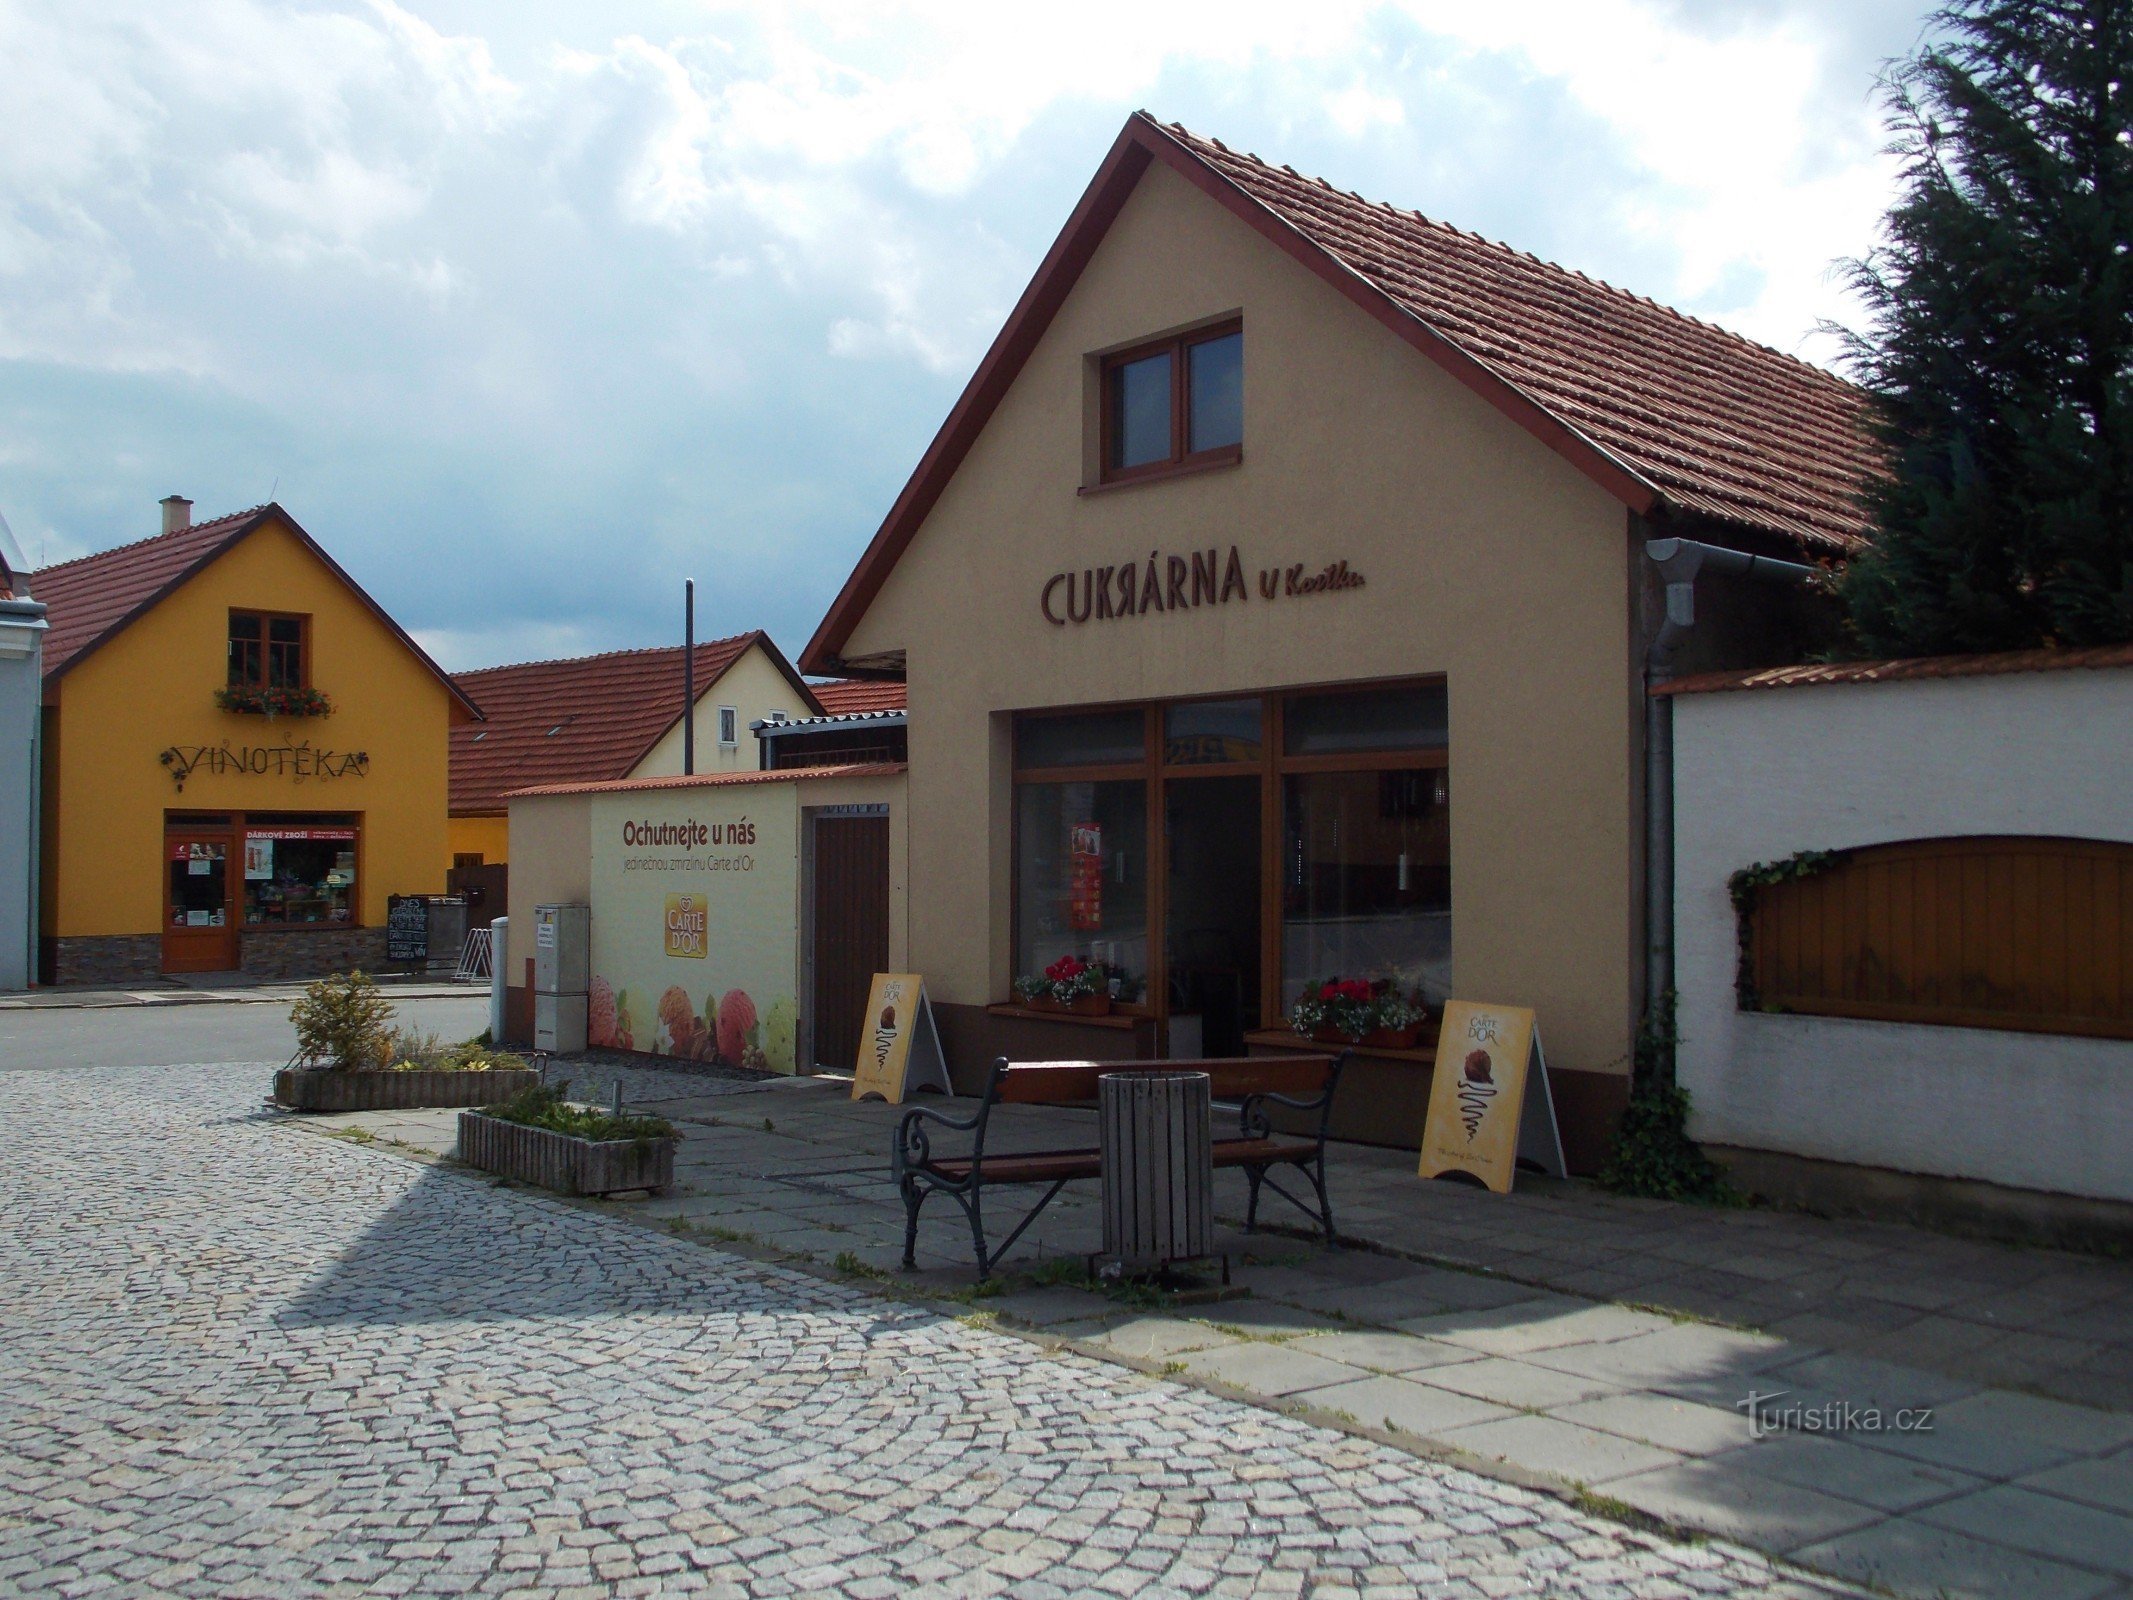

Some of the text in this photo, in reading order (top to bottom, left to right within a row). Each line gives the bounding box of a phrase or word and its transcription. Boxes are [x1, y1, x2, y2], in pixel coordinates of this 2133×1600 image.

[169, 739, 365, 778] VINOTÉKA
[246, 830, 283, 839] DÁRKOVÉ
[623, 815, 756, 851] Ochutnejte u nás
[623, 855, 668, 873] jedinečnou
[669, 855, 705, 871] zmrzlinu
[707, 854, 731, 871] Carte
[669, 909, 704, 934] CARTE
[1470, 1016, 1498, 1029] CARTE
